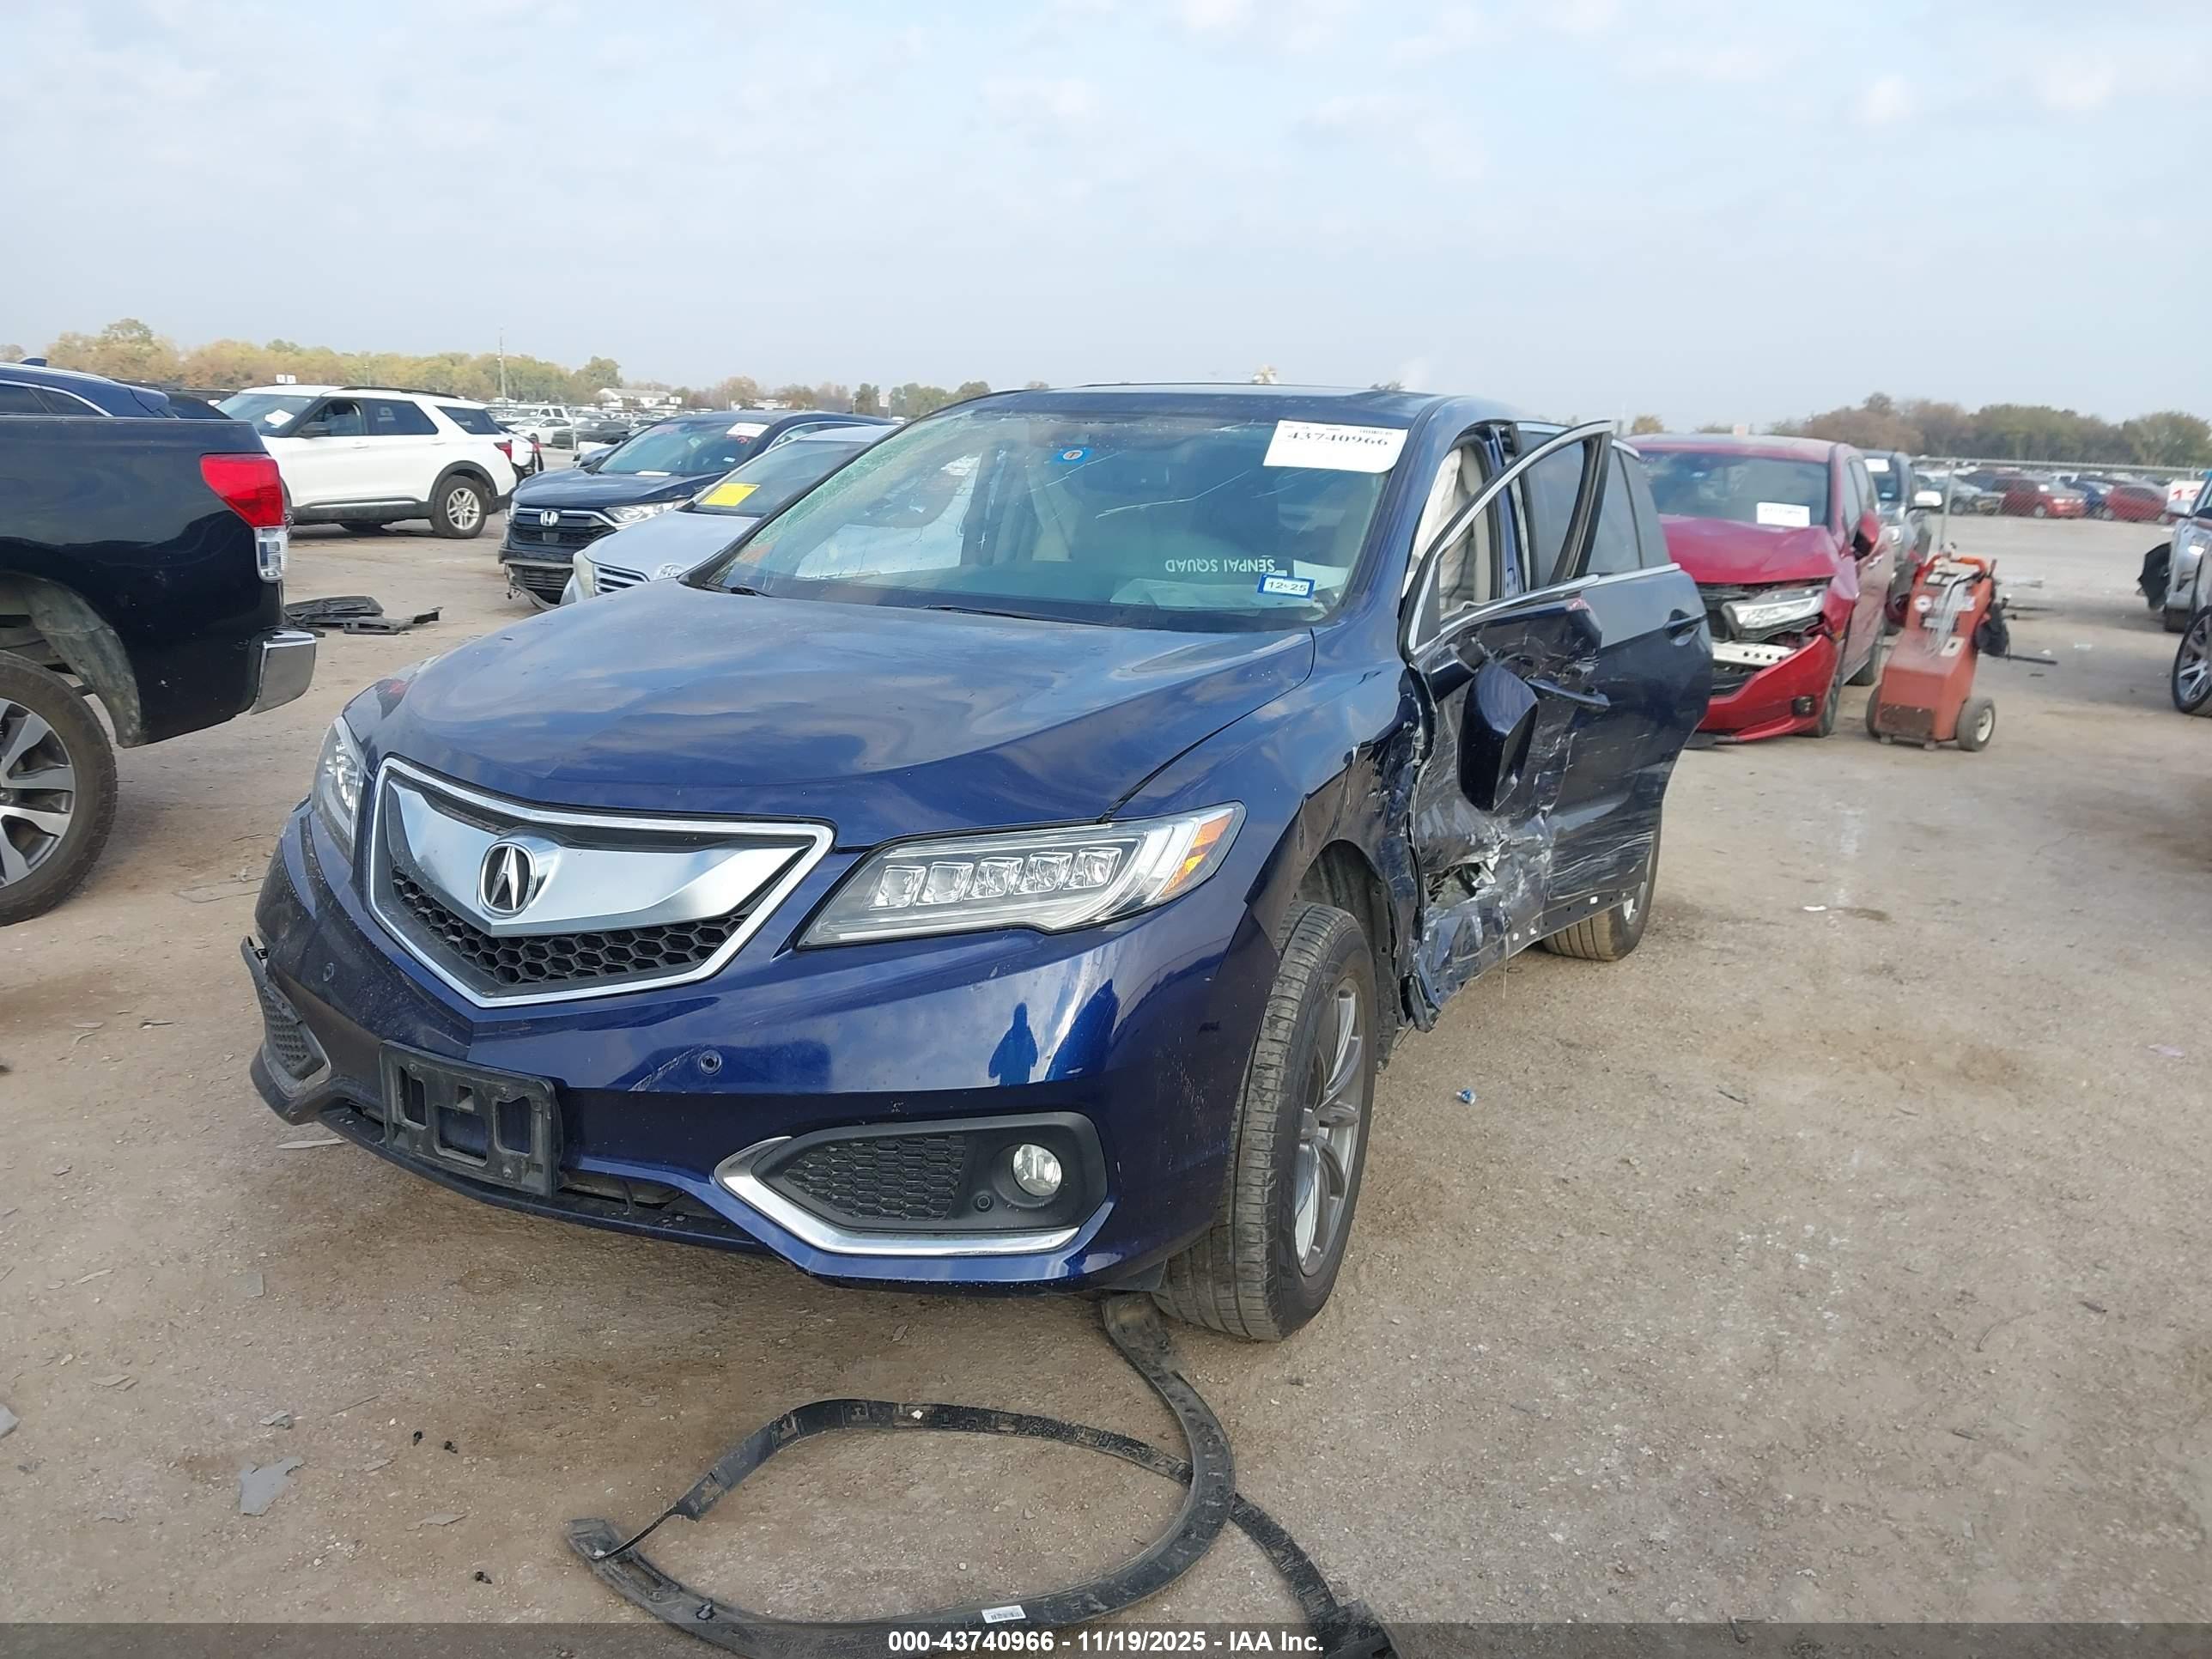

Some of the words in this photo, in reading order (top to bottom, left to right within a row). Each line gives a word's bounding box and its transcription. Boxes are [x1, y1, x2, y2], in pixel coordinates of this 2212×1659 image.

[1286, 432, 1389, 446] 43740966
[1165, 559, 1218, 573] SQUAD
[1224, 559, 1275, 573] SENPAI
